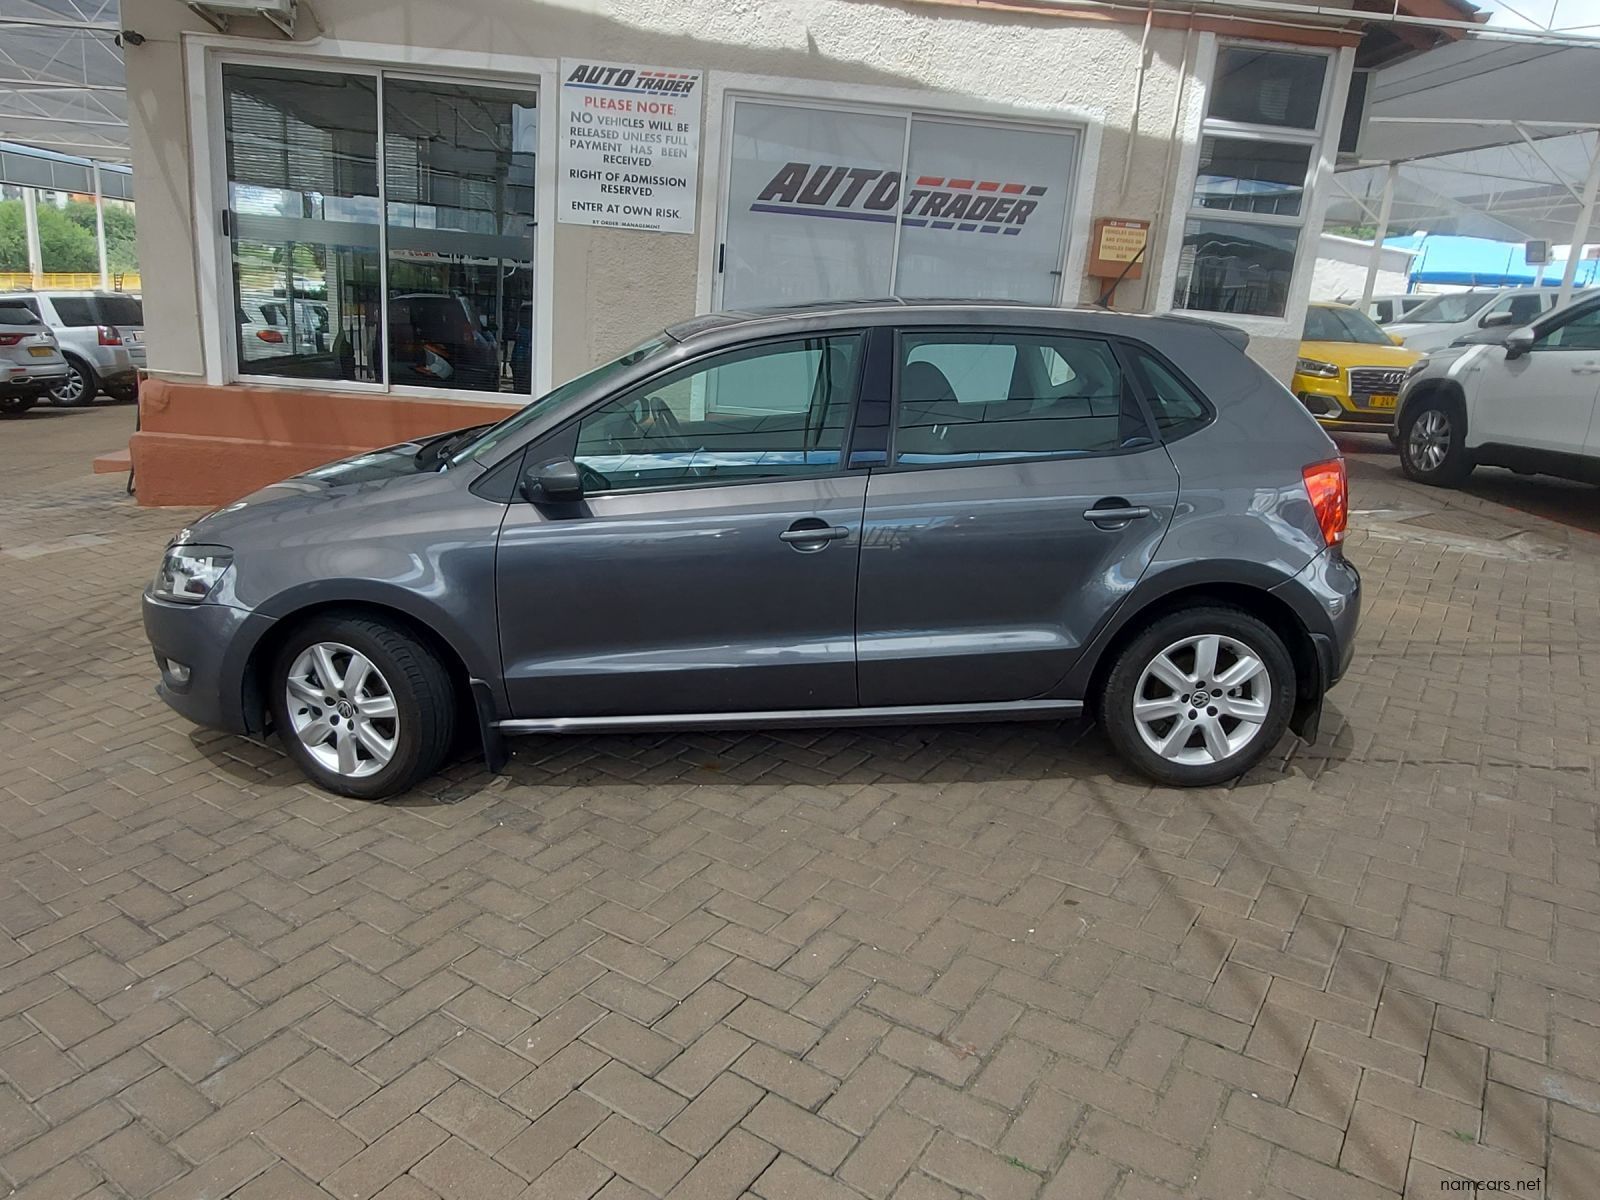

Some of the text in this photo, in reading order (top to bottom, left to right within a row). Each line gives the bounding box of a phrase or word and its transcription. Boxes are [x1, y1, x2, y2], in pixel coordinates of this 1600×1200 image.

[567, 64, 695, 93] AUTO TRADER
[584, 96, 633, 112] PLEASE
[570, 111, 689, 132] NO VEHICLES WILL BE
[570, 126, 689, 146] RELEASED UNLESS FULL
[569, 139, 688, 158] PAYMENT HAS BEEN
[569, 168, 687, 188] RIGHT OF ADMISSION
[757, 161, 1039, 225] AUTO TRADER
[571, 201, 603, 212] ENTER
[606, 204, 620, 214] AT
[623, 205, 652, 216] OWN
